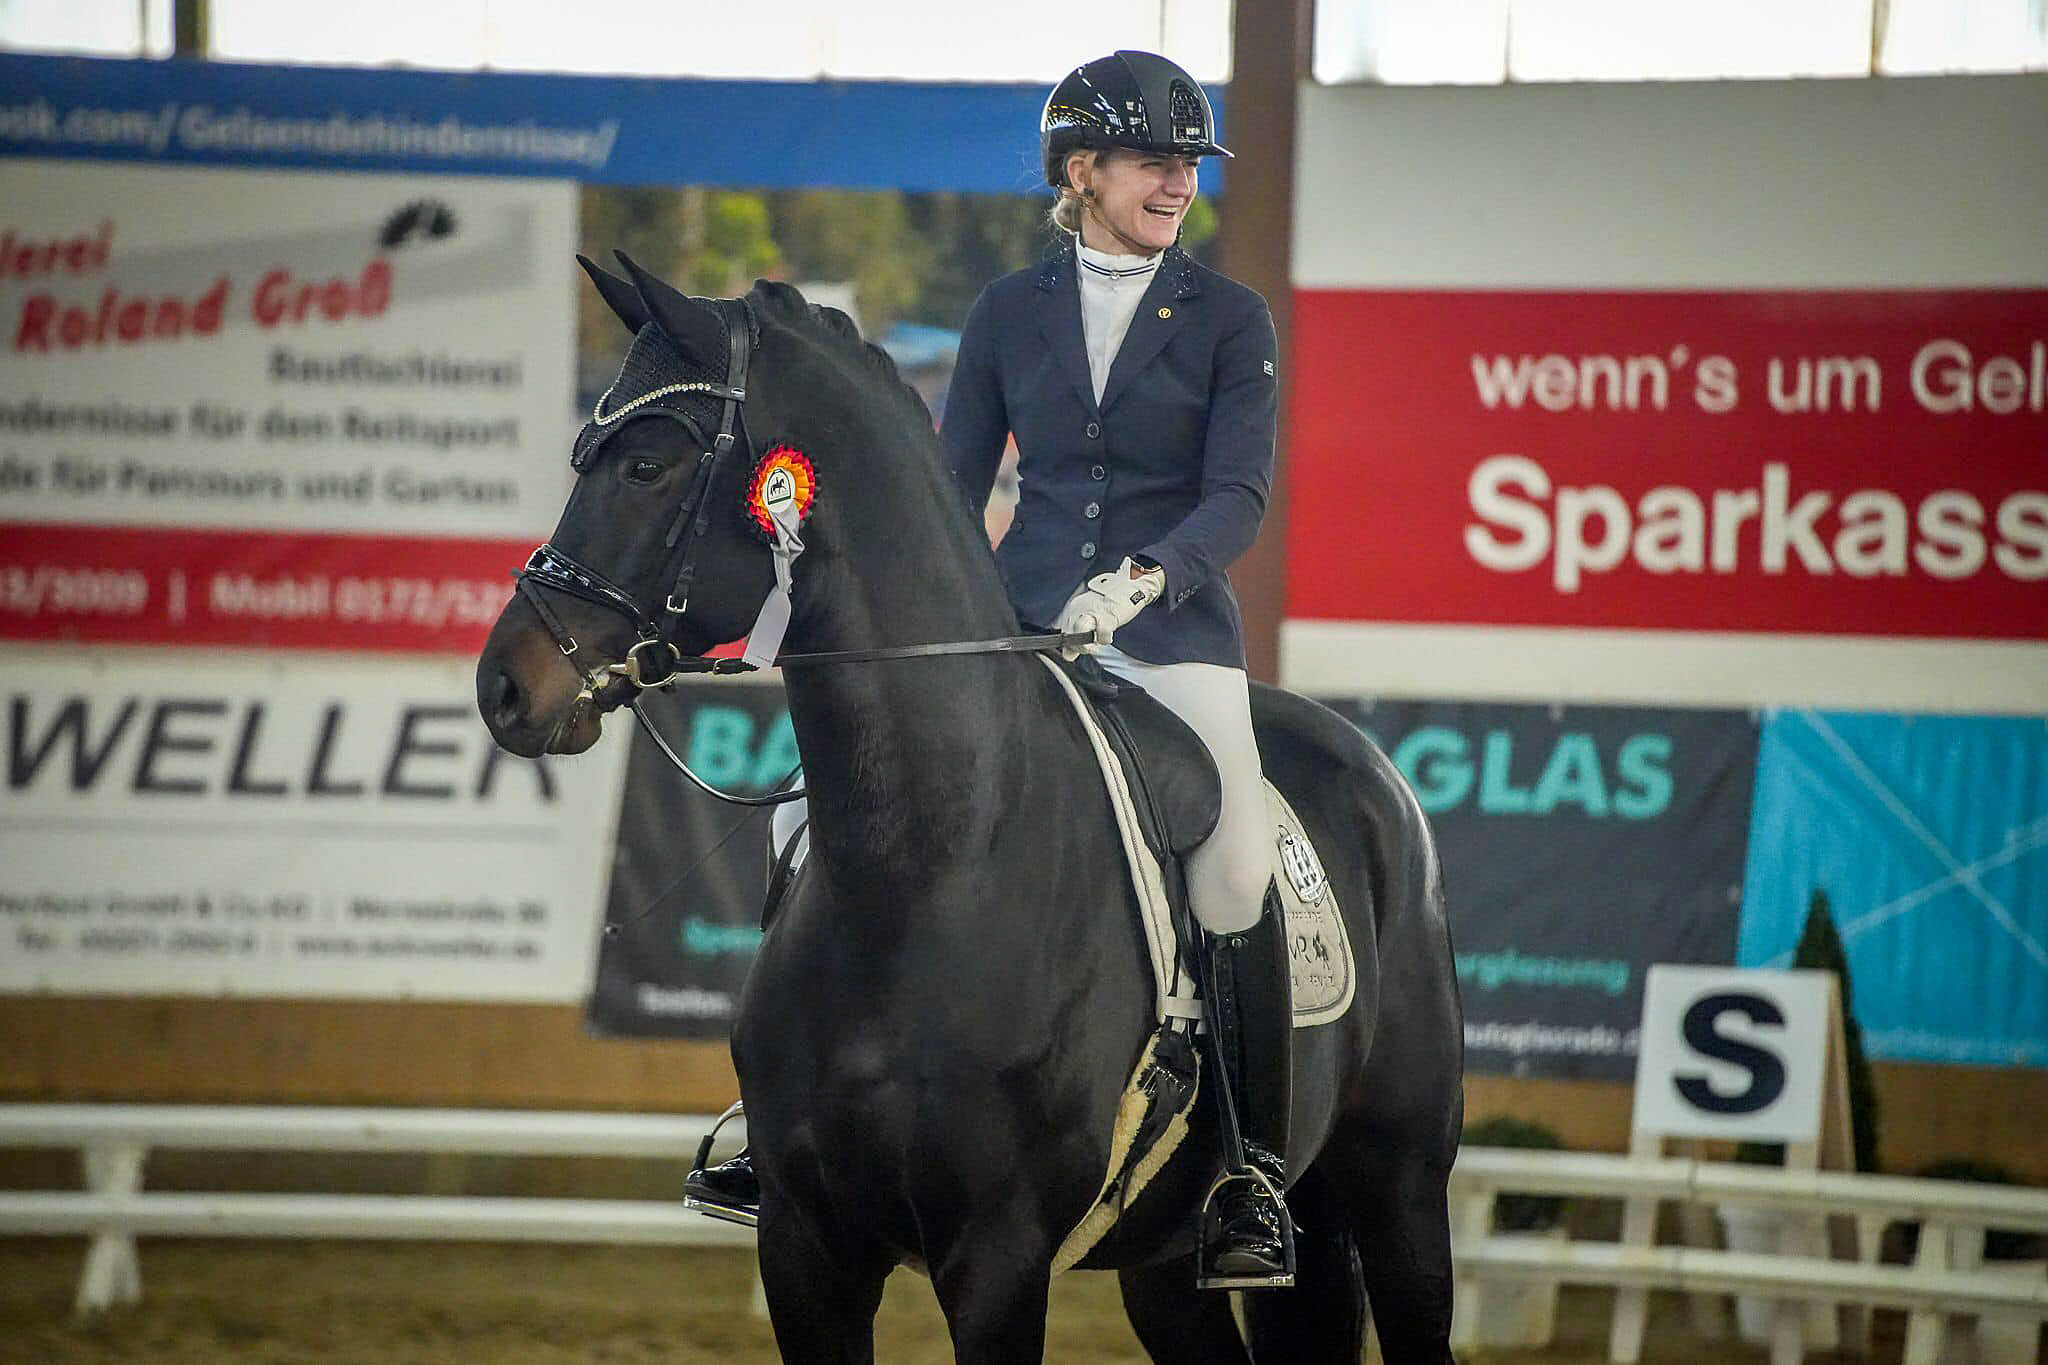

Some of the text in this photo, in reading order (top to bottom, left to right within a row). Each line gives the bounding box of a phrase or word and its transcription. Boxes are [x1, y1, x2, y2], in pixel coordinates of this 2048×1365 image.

[15, 257, 393, 352] Roland Groß
[1767, 356, 1882, 413] um
[192, 400, 246, 436] für
[257, 406, 332, 440] den
[343, 406, 519, 452] Reitsport
[53, 457, 107, 494] für
[120, 457, 284, 497] Parcours
[302, 465, 374, 499] und
[385, 466, 519, 502] Garten
[1464, 454, 2048, 593] Sparkass
[210, 575, 330, 617] Mobil
[1392, 726, 1673, 819] GLAS
[1673, 992, 1786, 1114] S
